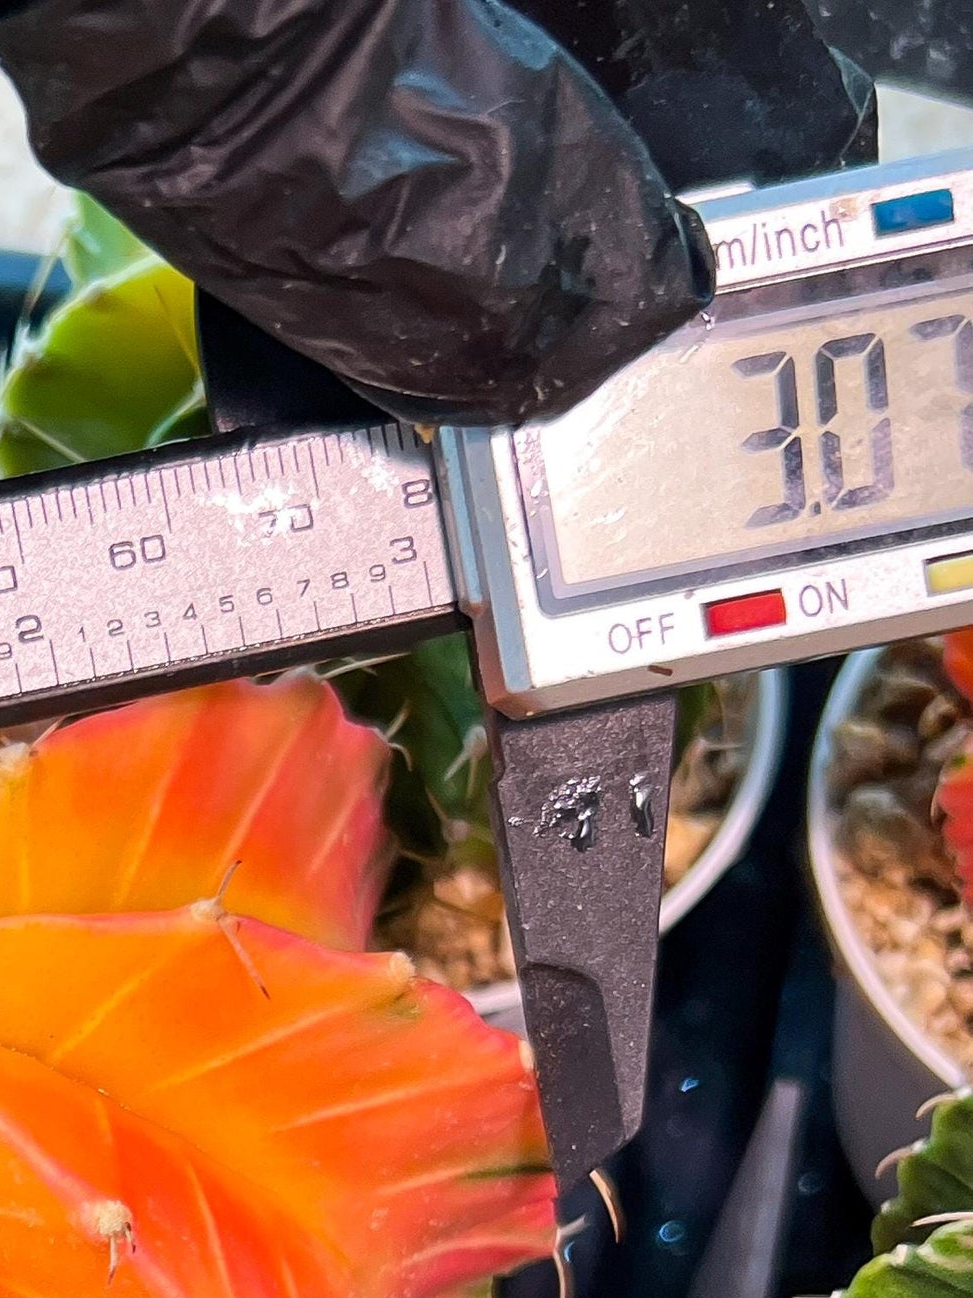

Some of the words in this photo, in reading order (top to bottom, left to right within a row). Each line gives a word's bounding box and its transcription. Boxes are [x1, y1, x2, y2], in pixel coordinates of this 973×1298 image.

[714, 209, 845, 270] m/inch
[108, 535, 166, 570] 60
[258, 503, 314, 538] 70
[402, 479, 432, 507] 8
[15, 615, 44, 643] 2
[78, 627, 86, 642] 1
[107, 619, 124, 636] 2
[144, 611, 161, 628] 3
[183, 603, 197, 619] 4
[219, 595, 234, 613] 5
[257, 588, 273, 605] 6
[297, 579, 310, 597] 7
[330, 572, 349, 589] 8
[369, 564, 386, 582] 9
[390, 536, 417, 564] 3
[608, 613, 675, 654] OFF
[799, 579, 849, 617] ON
